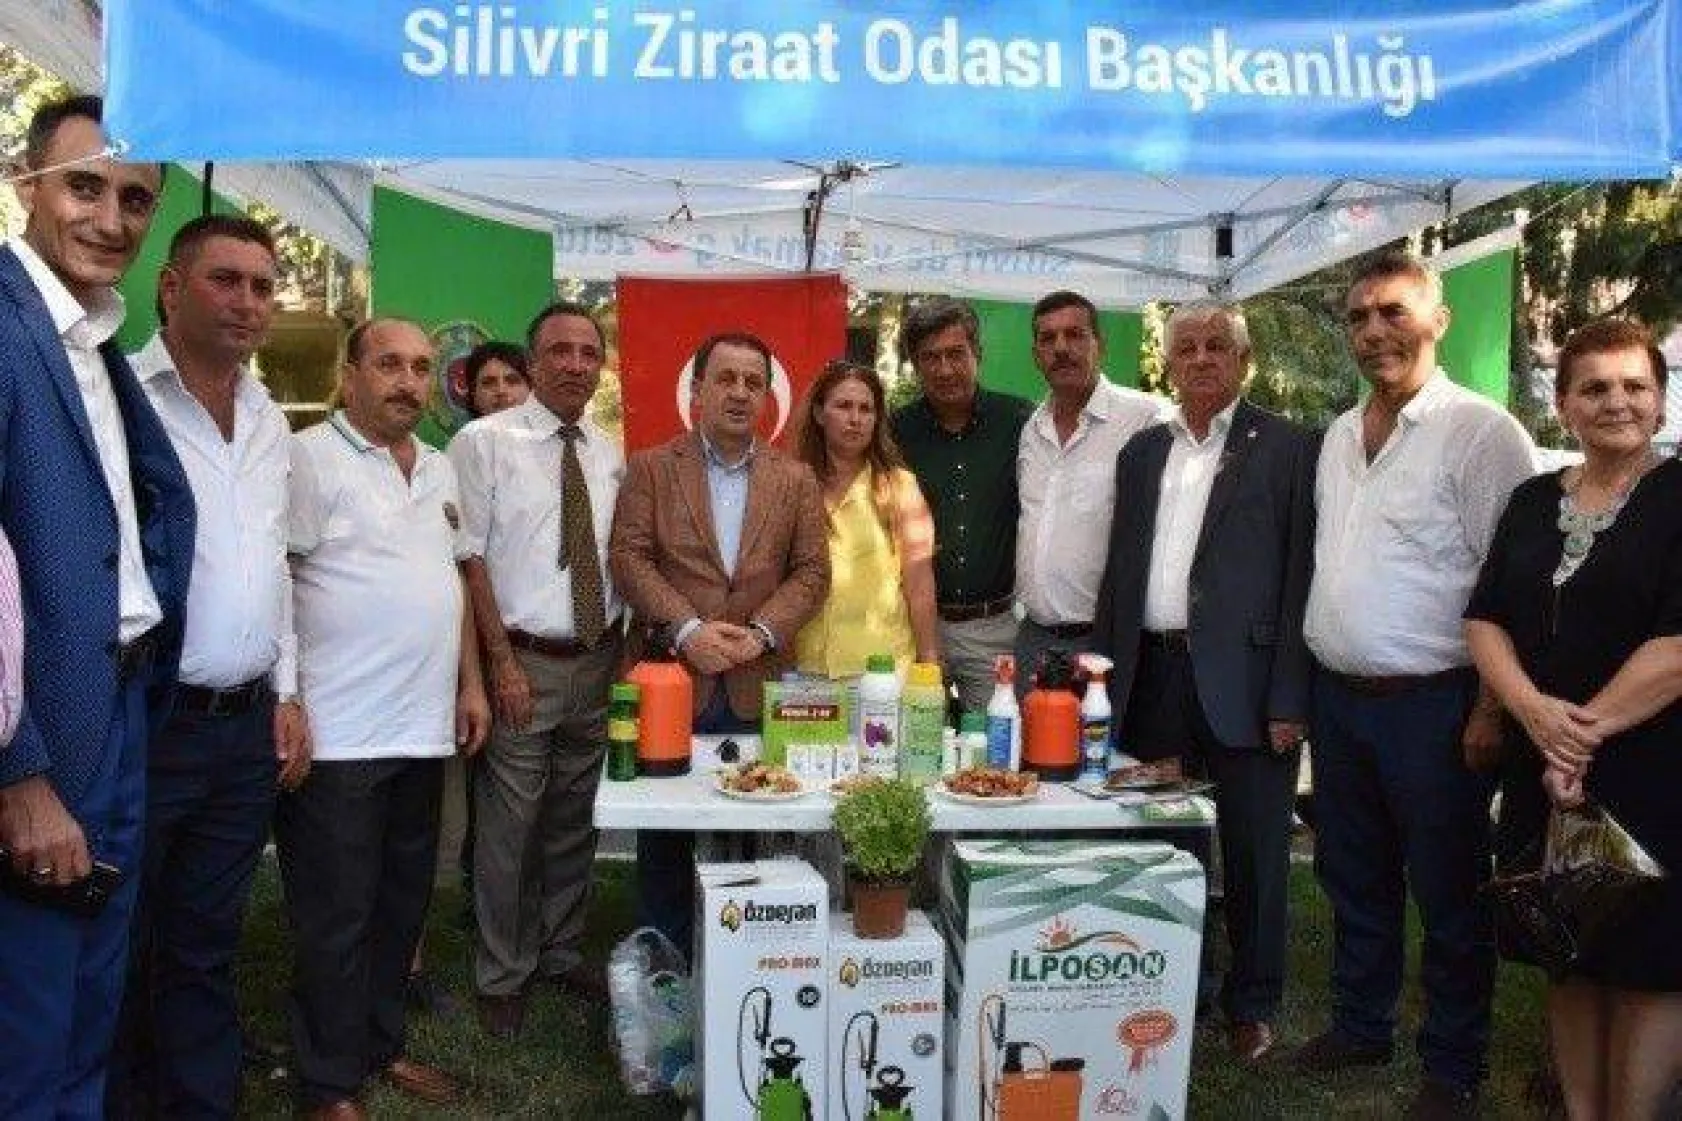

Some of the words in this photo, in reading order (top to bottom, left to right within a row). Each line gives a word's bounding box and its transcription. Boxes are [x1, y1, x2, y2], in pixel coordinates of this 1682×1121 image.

[402, 4, 607, 77] Silivri
[634, 12, 840, 83] Ziraat
[864, 17, 1060, 88] Odası
[1088, 24, 1435, 117] Başkanlığı
